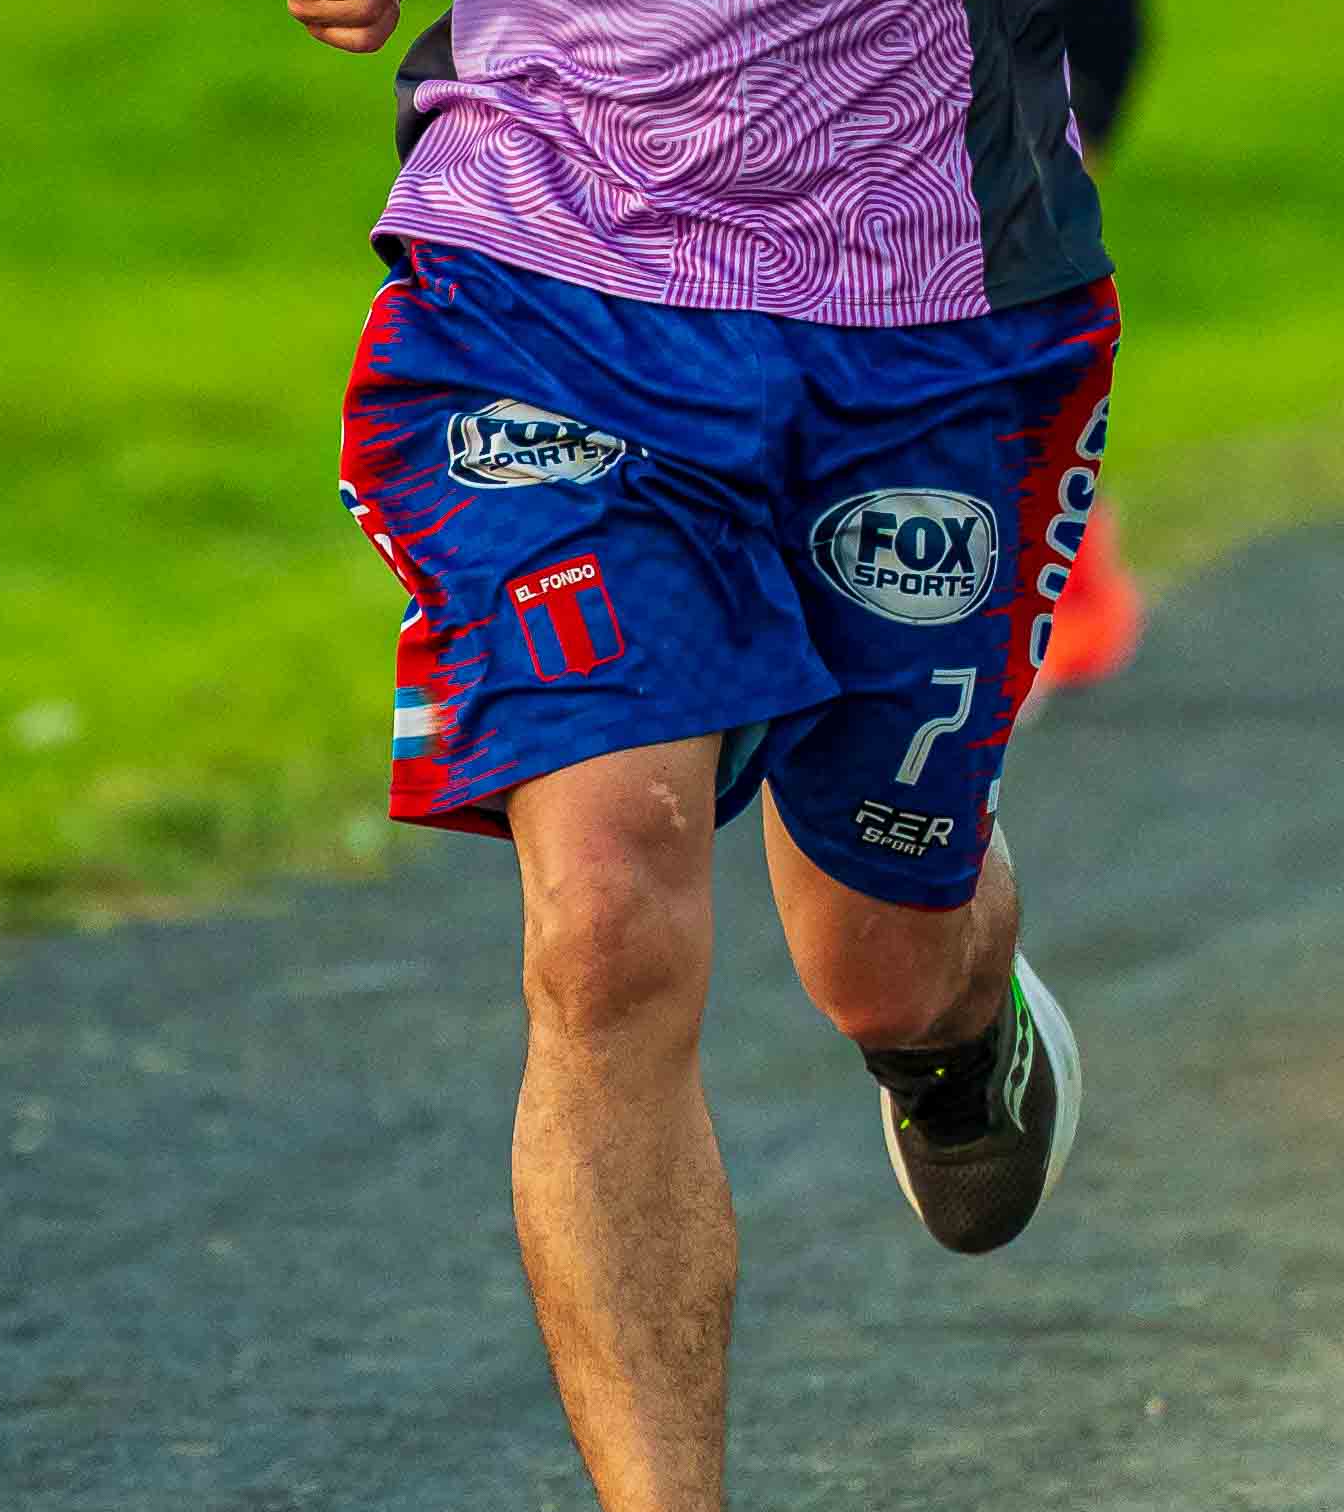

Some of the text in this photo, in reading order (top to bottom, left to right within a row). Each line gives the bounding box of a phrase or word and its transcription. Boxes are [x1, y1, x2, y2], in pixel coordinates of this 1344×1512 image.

[857, 510, 979, 574] FOX
[515, 564, 596, 603] EL FONDO
[853, 564, 976, 597] SPORTS
[895, 667, 977, 785] 7
[856, 800, 954, 846] FER
[862, 827, 927, 856] SPORT
